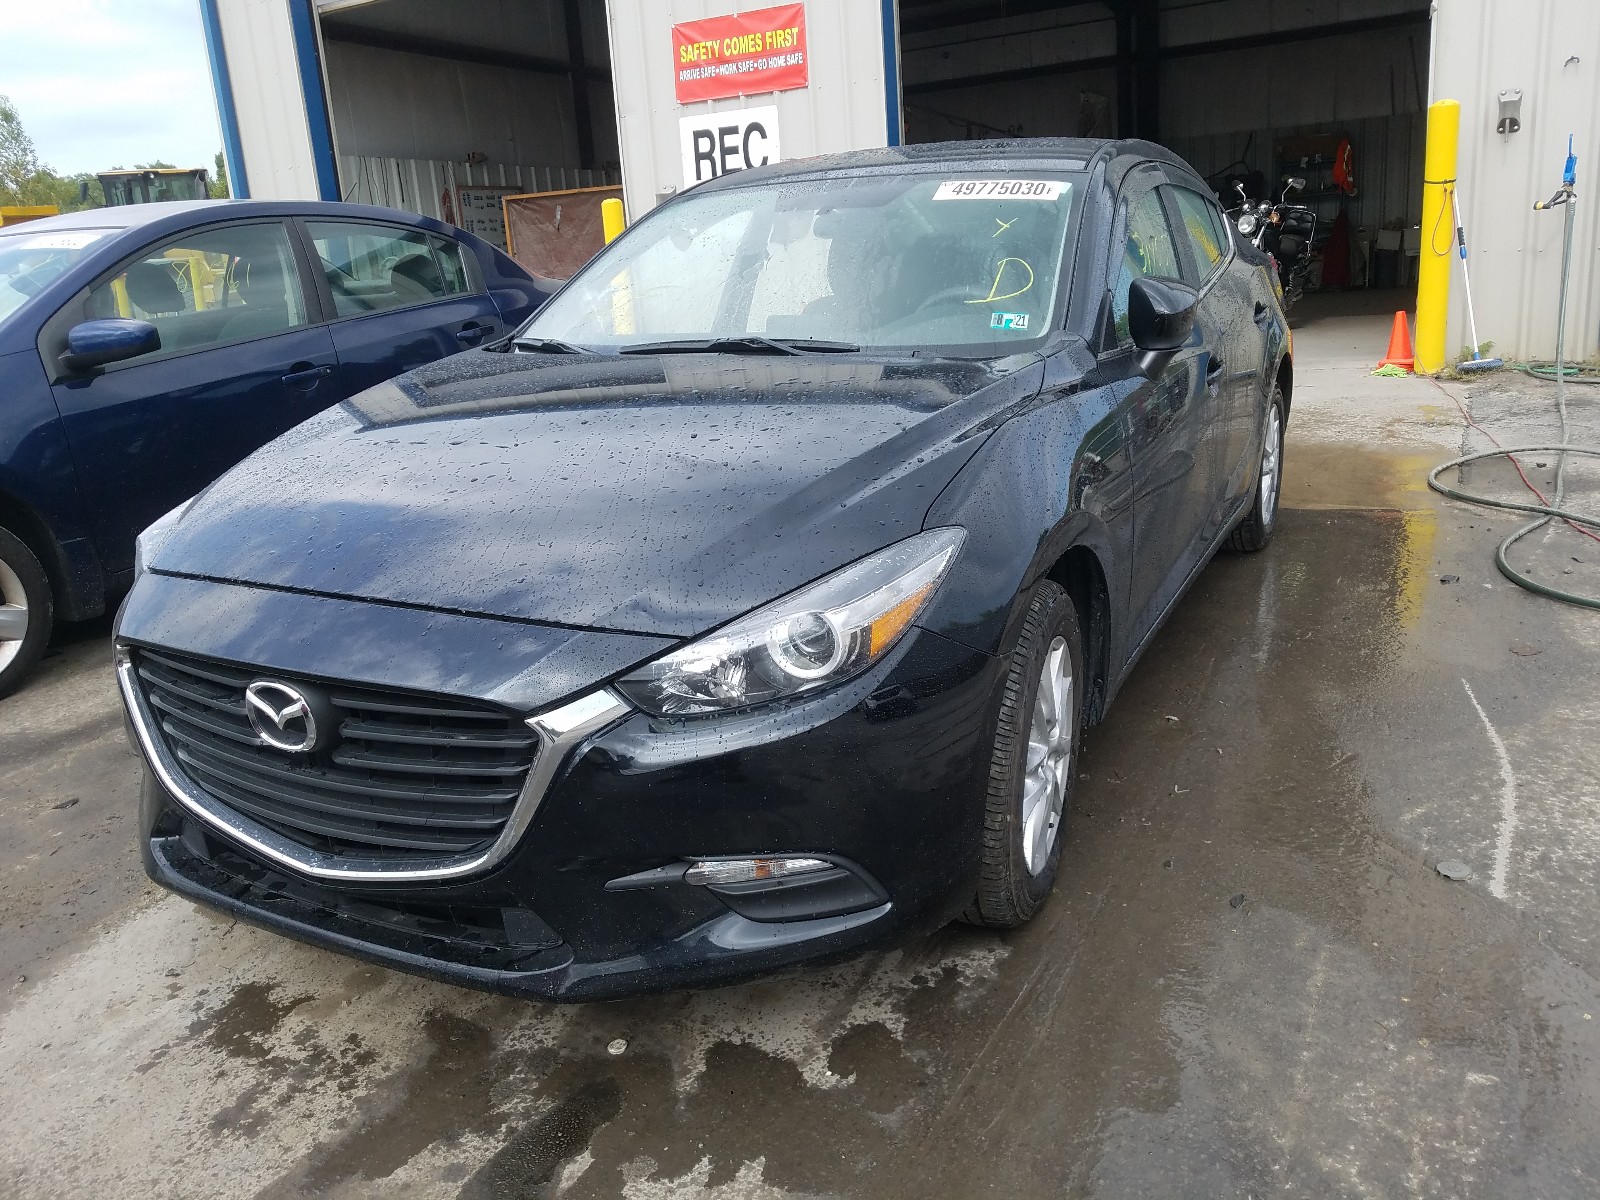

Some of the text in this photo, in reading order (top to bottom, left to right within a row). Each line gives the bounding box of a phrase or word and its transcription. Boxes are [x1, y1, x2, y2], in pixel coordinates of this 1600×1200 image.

[680, 27, 799, 63] SAFETY COMES FIRST
[680, 52, 804, 81] ARRIVE SAFE WORK SAFE GO HOME SAFE
[692, 121, 769, 181] REC
[952, 181, 1047, 196] 49775030
[963, 257, 1034, 304] D
[1015, 314, 1026, 327] 21
